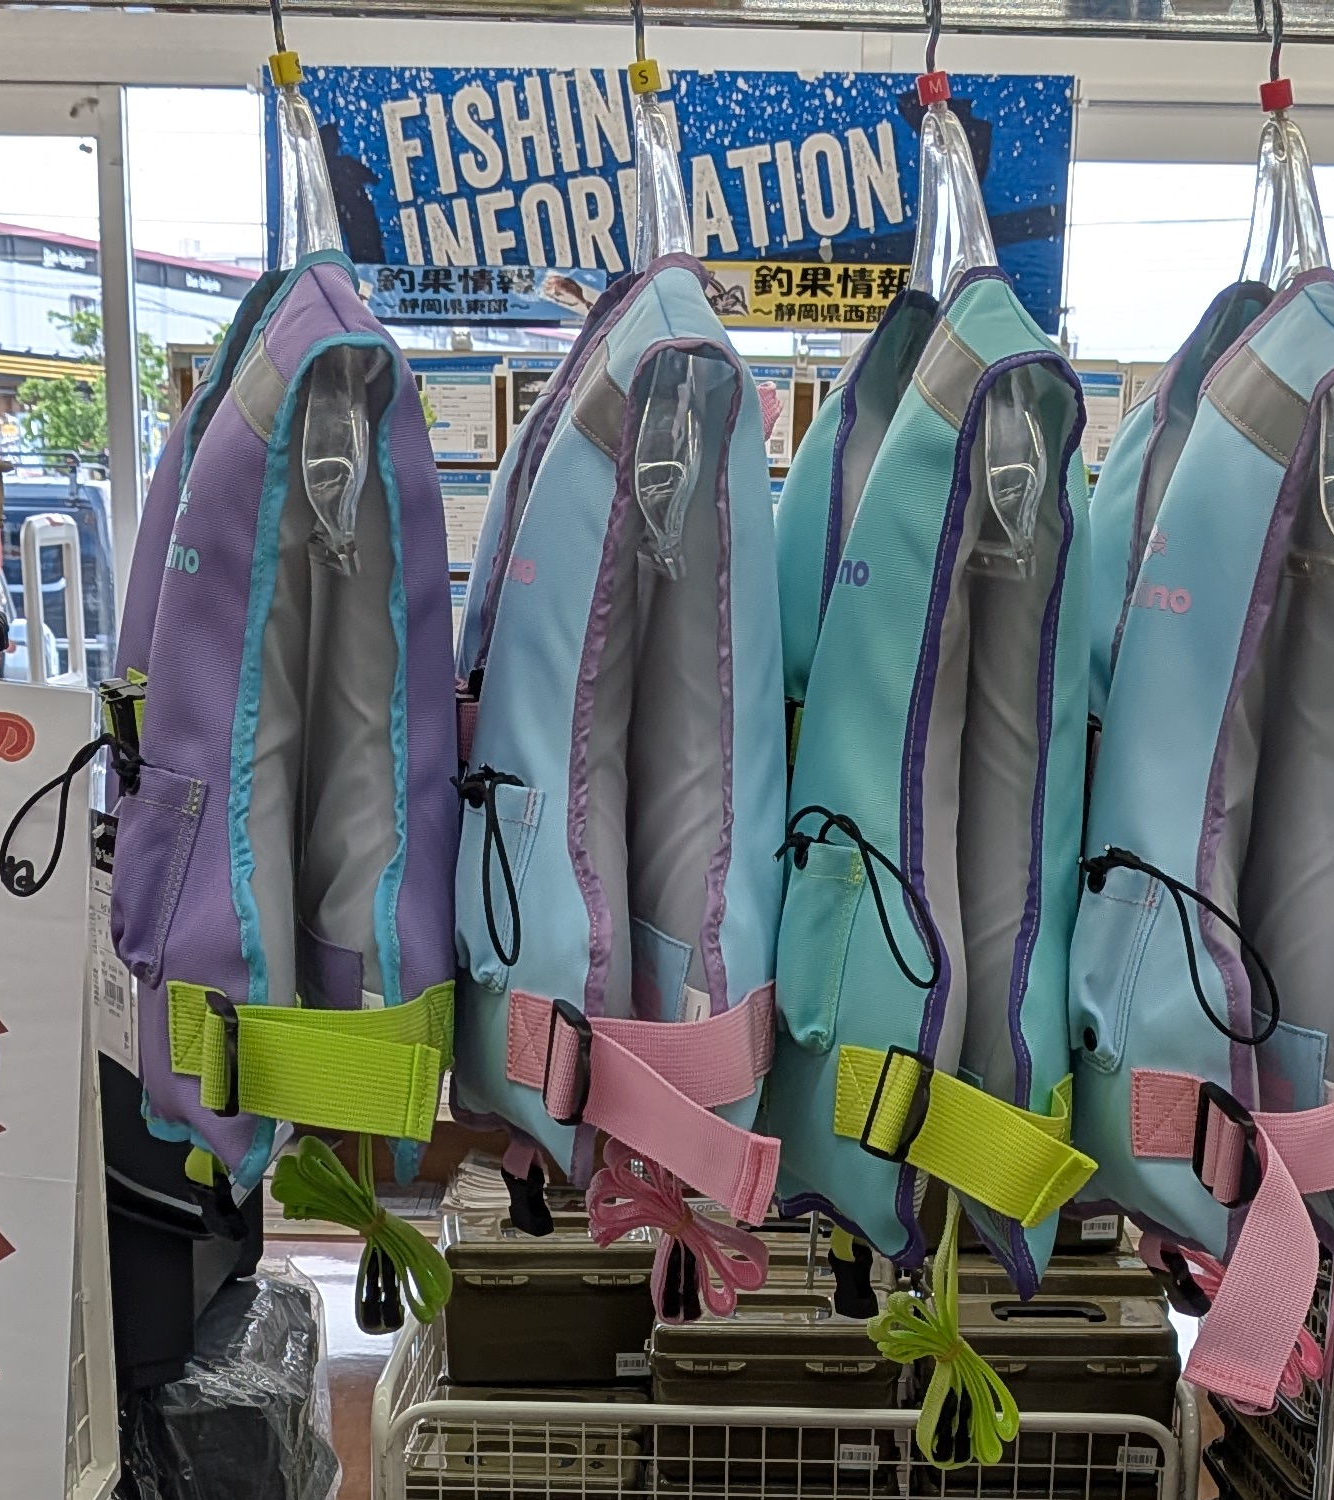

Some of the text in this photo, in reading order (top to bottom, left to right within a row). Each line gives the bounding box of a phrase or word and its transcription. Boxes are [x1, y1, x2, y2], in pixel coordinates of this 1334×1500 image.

[638, 69, 650, 85] S
[928, 78, 943, 95] M
[382, 68, 683, 203] FISHIN
[400, 120, 905, 274] INFORATION
[376, 266, 536, 296] 釣果情報
[754, 263, 910, 298] 釣果情報
